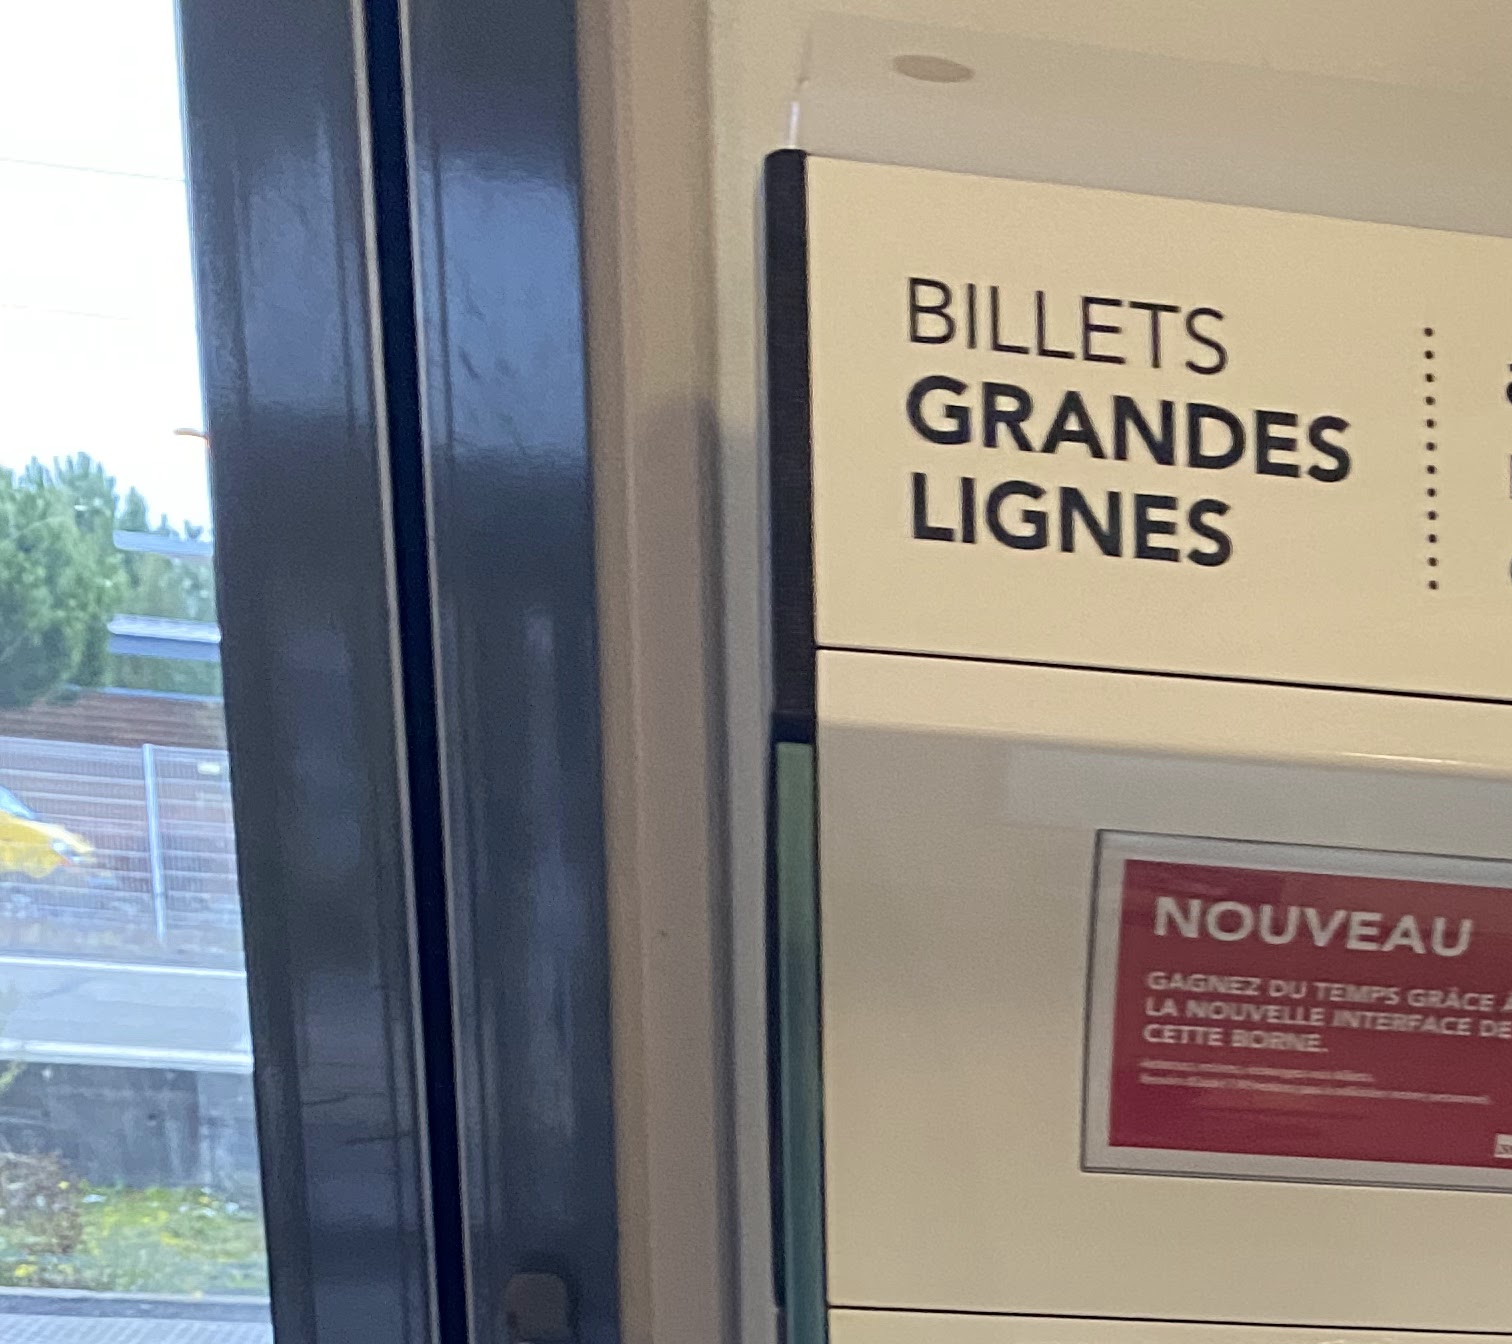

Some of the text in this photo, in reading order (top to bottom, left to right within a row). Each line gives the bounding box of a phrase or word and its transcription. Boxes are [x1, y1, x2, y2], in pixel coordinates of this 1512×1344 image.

[907, 277, 1229, 375] BILLETS
[906, 375, 1352, 484] GRANDES
[911, 473, 1233, 566] LIGNES
[1153, 896, 1474, 957] NOUVEAU
[1145, 997, 1179, 1017] LA
[1185, 999, 1325, 1026] NOUVELLE
[1332, 1009, 1472, 1036] INTERFACE
[1148, 971, 1261, 996] GAGNEZ
[1268, 979, 1308, 999] DU
[1314, 981, 1399, 1006] TEMPS
[1407, 986, 1494, 1012] GRÂCE
[1143, 1024, 1329, 1053] CETTE BORNE.
